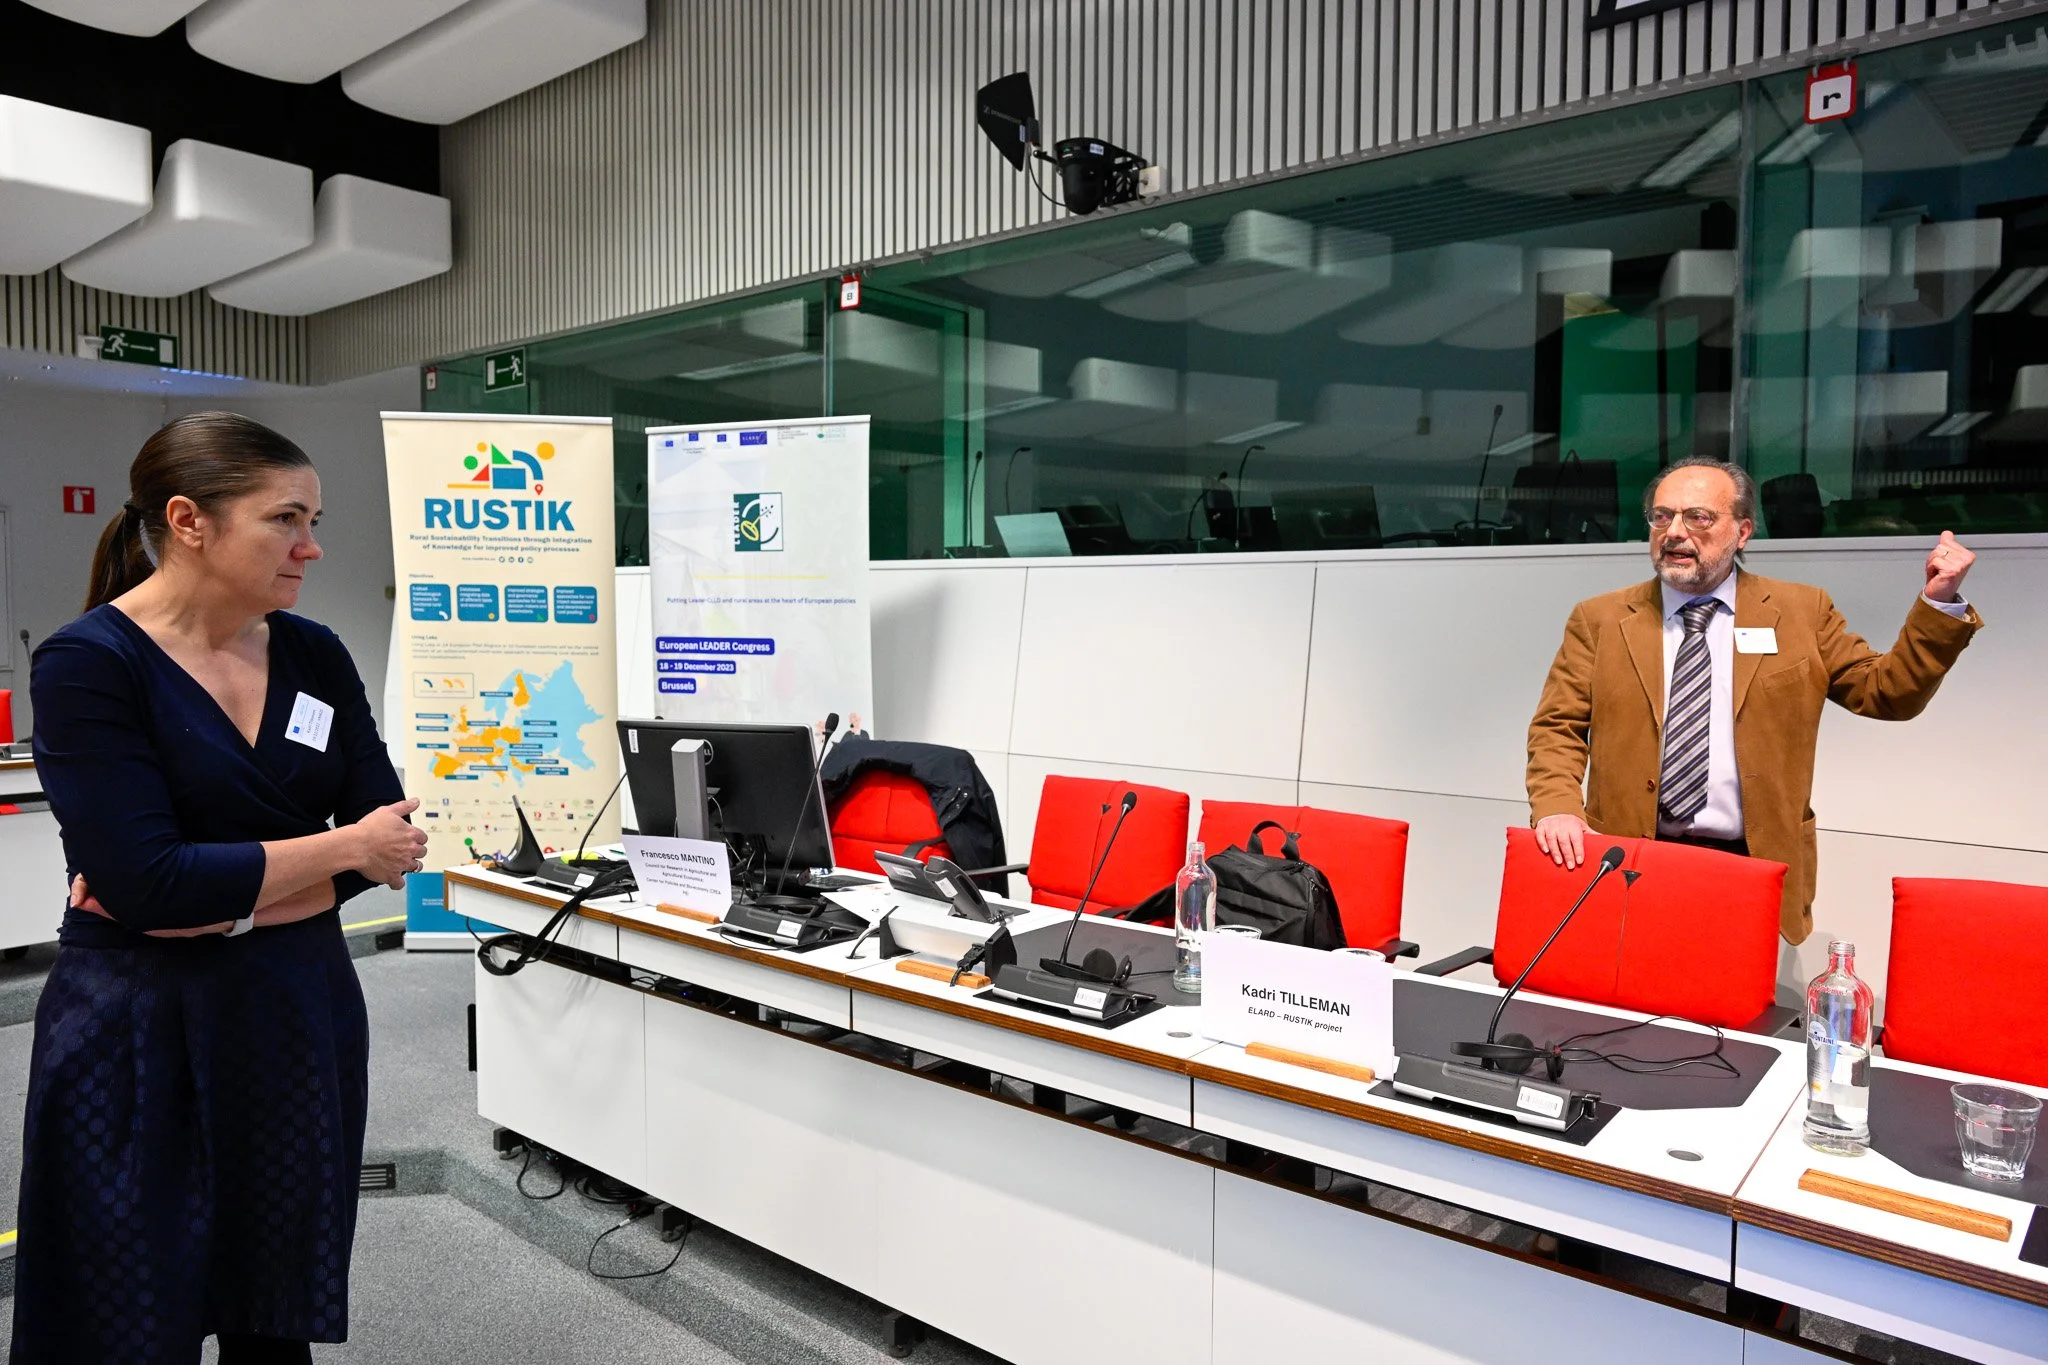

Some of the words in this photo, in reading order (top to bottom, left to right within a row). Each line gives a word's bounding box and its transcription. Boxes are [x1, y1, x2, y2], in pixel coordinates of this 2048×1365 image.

[1822, 92, 1842, 110] r
[424, 498, 575, 531] RUSTIK
[659, 641, 698, 651] European
[699, 641, 731, 651] LEADER
[732, 642, 770, 653] Congress
[659, 662, 669, 670] 18
[674, 662, 683, 670] 19
[684, 663, 716, 671] December
[716, 663, 735, 672] 2023
[661, 682, 695, 691] Brussels
[640, 849, 680, 861] Francesco
[680, 853, 716, 866] MANTINO
[1241, 984, 1276, 1002] Kadri
[1280, 991, 1350, 1017] TILLEMAN
[1248, 1006, 1276, 1019] ELARD
[1283, 1013, 1313, 1027] RUSTIK
[1314, 1021, 1343, 1033] project
